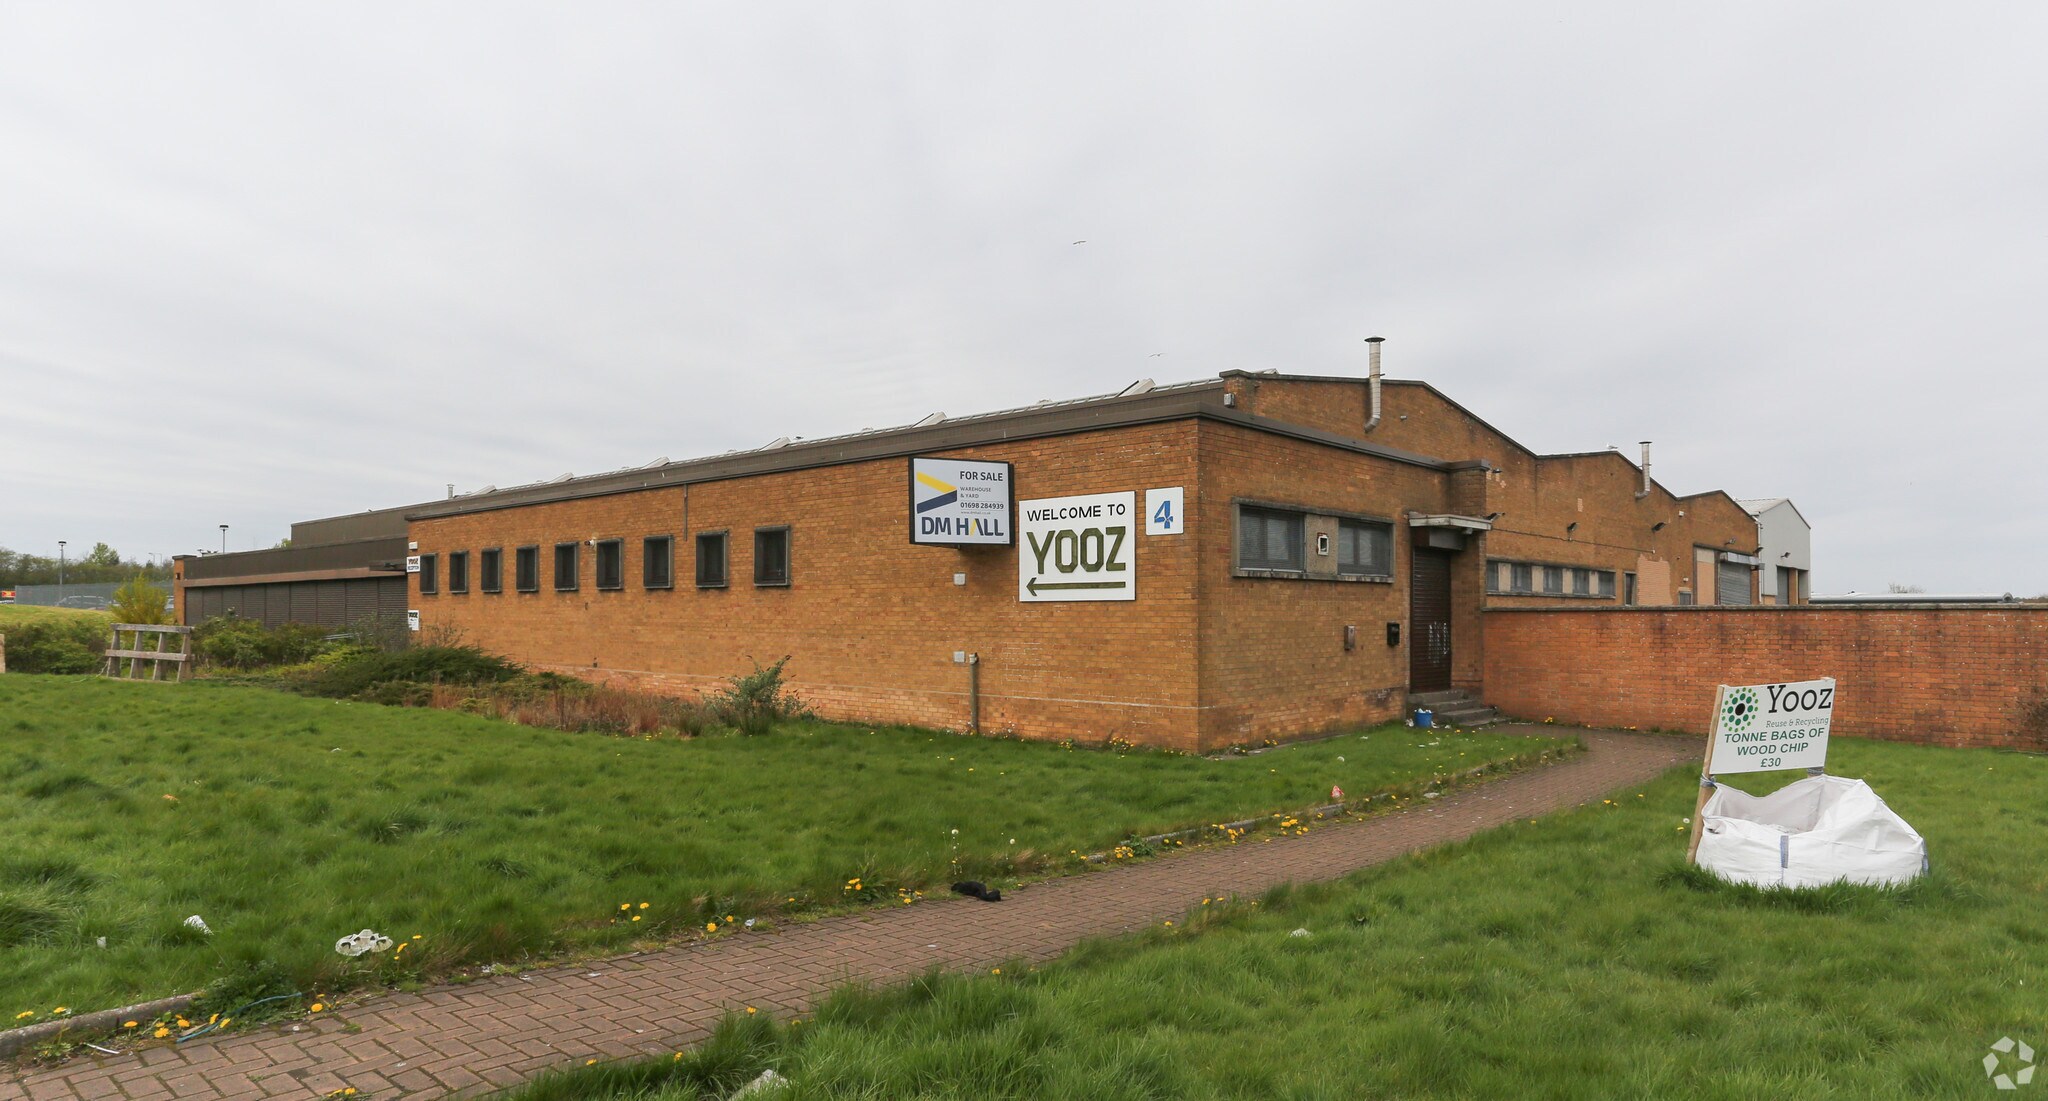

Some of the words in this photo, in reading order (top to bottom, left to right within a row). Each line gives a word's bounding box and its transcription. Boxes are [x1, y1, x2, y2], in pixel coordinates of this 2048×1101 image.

[960, 471, 978, 481] FOR
[980, 472, 1004, 481] SALE
[980, 502, 1004, 510] 284939
[1027, 505, 1101, 522] WELCOME
[1107, 503, 1126, 516] TO
[1154, 500, 1174, 529] 4
[921, 516, 952, 536] DM
[956, 518, 1004, 537] HALL
[1026, 526, 1126, 575] YOOZ
[1766, 720, 1787, 728] Reuse
[1796, 717, 1829, 726] Recycling
[1724, 732, 1767, 743] TONNE
[1771, 729, 1805, 741] BAGS
[1808, 727, 1825, 738] OF
[1737, 745, 1777, 756] WOOD
[1780, 742, 1809, 753] CHIP
[1760, 757, 1781, 768] £30
